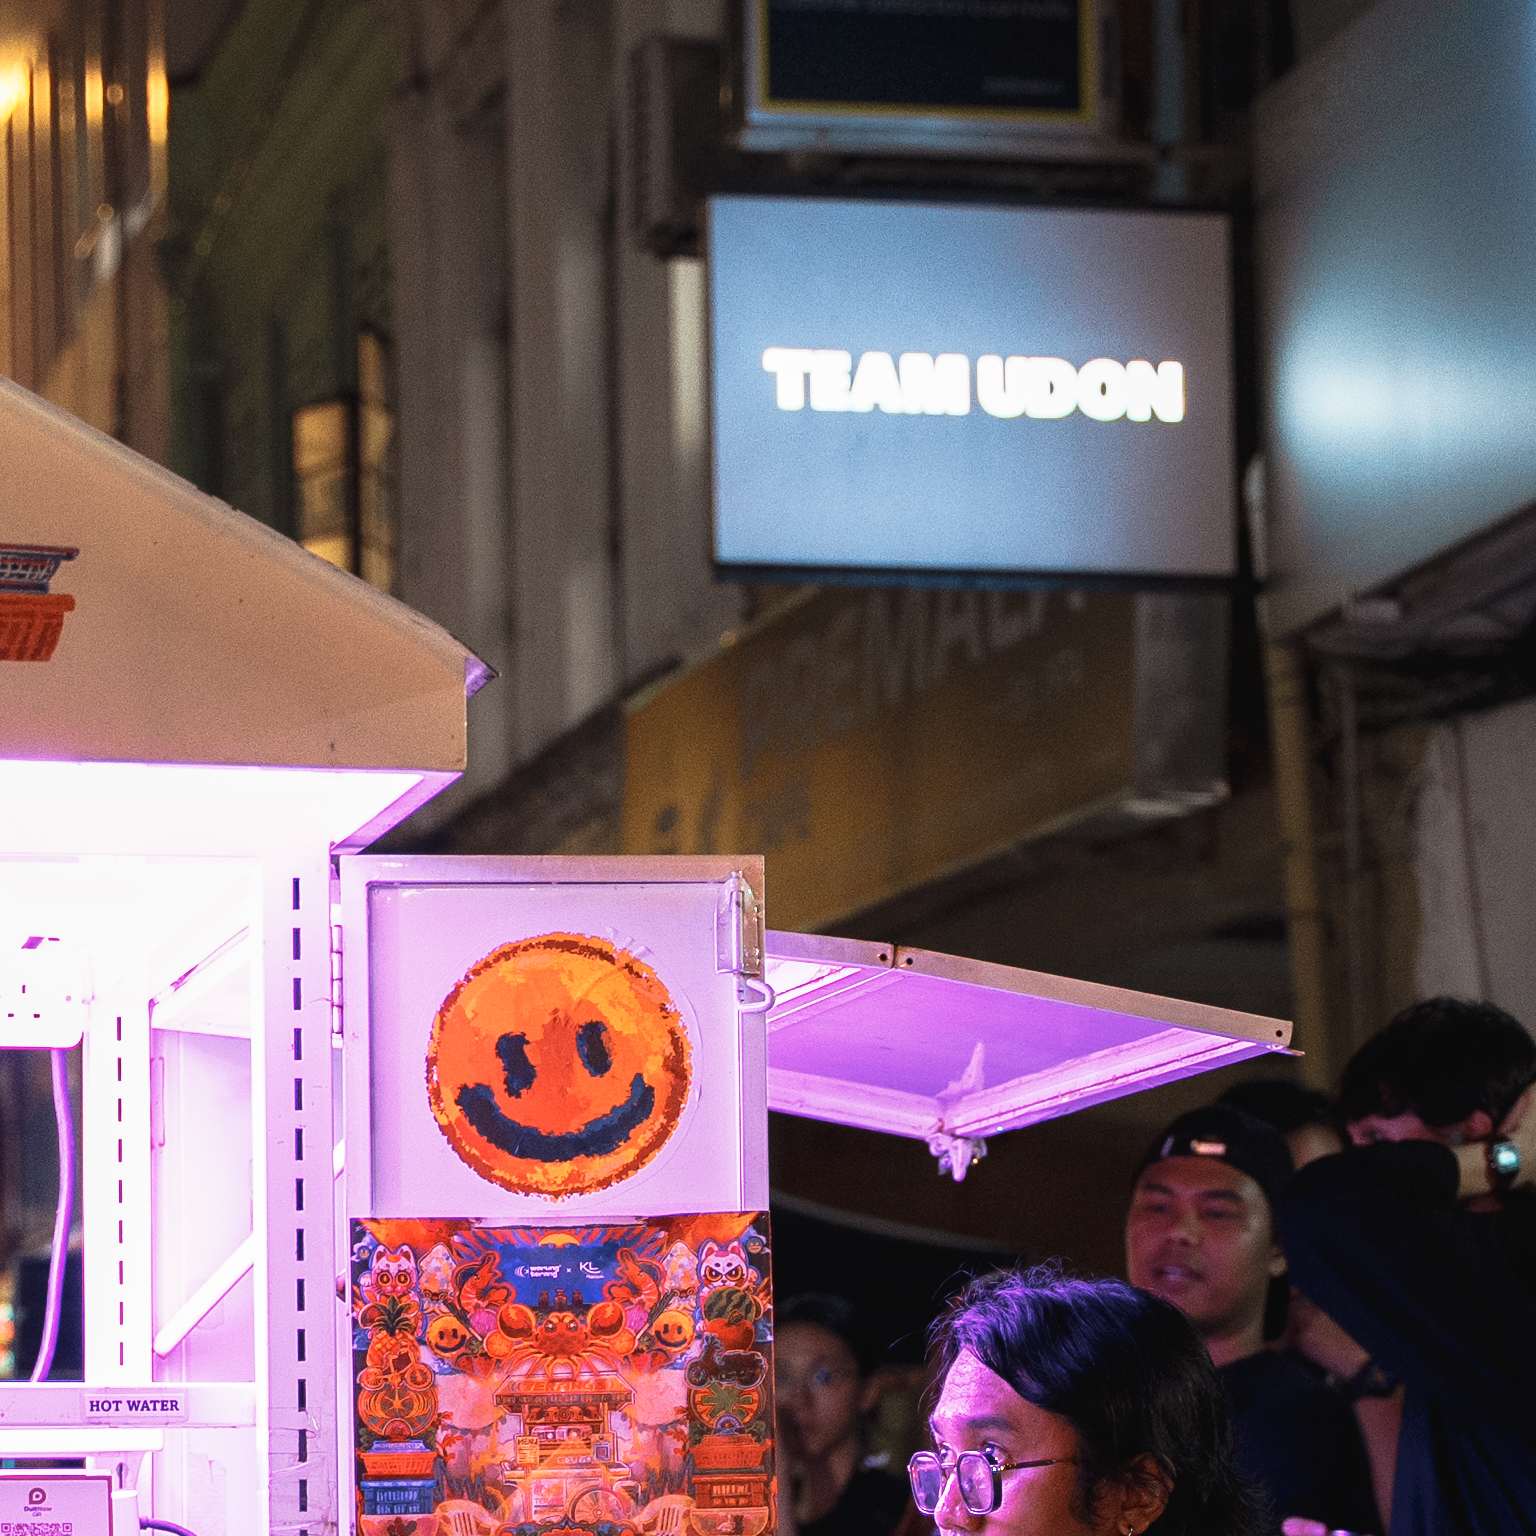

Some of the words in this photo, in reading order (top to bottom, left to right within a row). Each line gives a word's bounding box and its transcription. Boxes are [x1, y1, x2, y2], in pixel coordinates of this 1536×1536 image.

[762, 347, 970, 416] TEAM
[977, 354, 1186, 422] UDON
[89, 1400, 122, 1412] HOT
[126, 1399, 180, 1412] WATER
